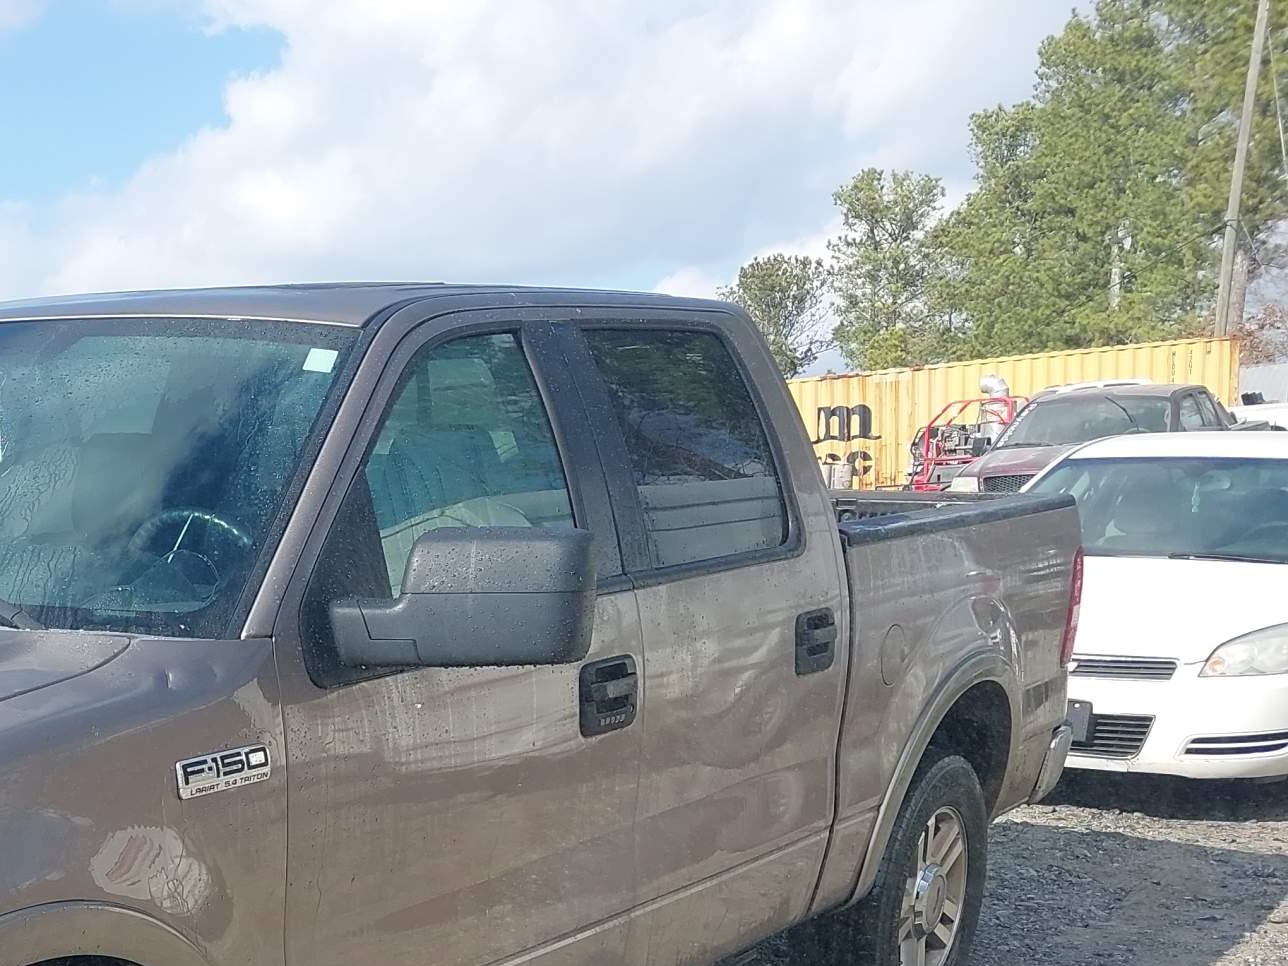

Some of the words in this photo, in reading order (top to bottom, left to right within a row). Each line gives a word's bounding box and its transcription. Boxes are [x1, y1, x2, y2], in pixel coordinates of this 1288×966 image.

[181, 746, 269, 786] F-150
[190, 783, 221, 796] LARIAT
[240, 771, 269, 785] TRITON
